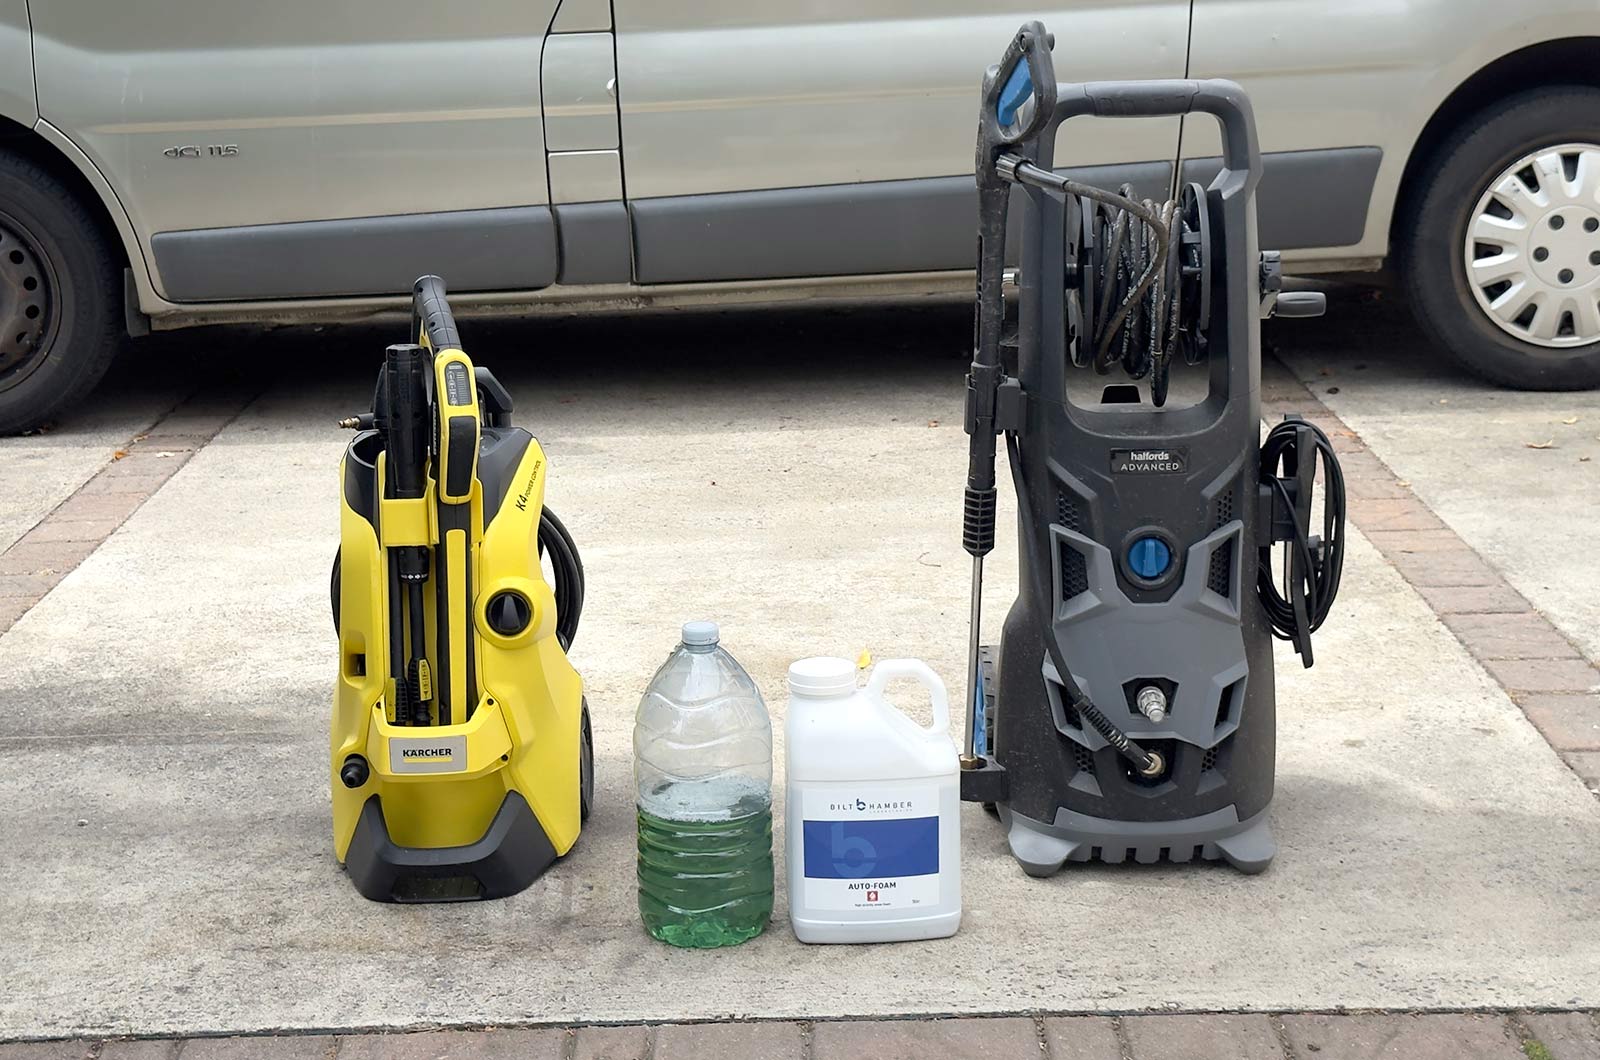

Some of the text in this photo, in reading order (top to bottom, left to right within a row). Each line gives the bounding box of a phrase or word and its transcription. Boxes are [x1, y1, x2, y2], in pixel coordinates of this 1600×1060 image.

[208, 144, 239, 157] 115
[1130, 452, 1170, 461] halfords
[1120, 463, 1180, 472] ADVANCED
[515, 494, 528, 512] K4
[848, 882, 897, 890] AUTO-FOAM
